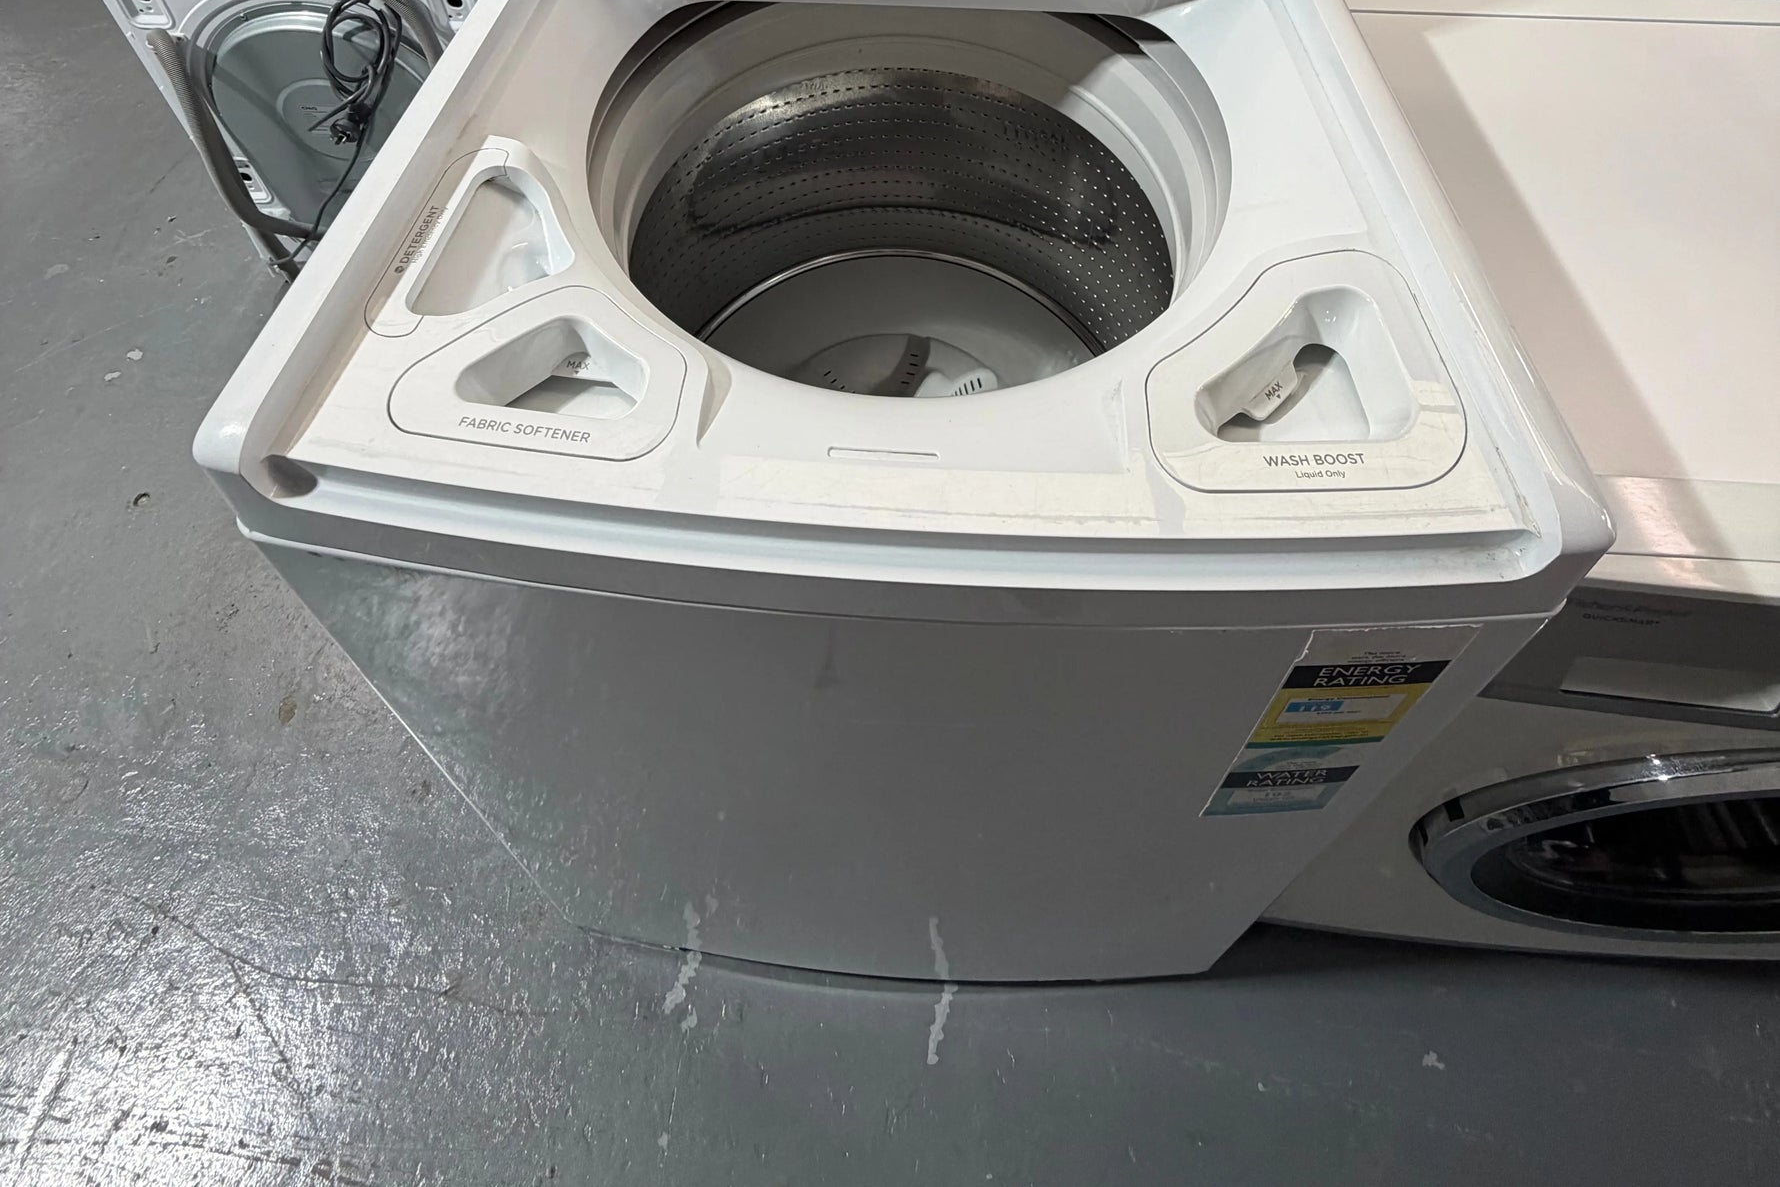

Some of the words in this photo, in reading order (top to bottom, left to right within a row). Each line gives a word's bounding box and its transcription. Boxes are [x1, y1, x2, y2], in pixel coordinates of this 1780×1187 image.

[399, 206, 439, 264] DETERGENT
[566, 359, 589, 371] MAX
[1264, 380, 1284, 401] MAX
[458, 417, 512, 434] FABRIC
[513, 423, 591, 444] SOFTENER
[1263, 454, 1309, 467] WASH
[1313, 453, 1365, 467] BOOST
[1295, 469, 1325, 480] Liquid
[1326, 469, 1346, 480] Only
[1319, 664, 1421, 677] ENERGY
[1313, 674, 1408, 687] RATING
[1257, 769, 1327, 779] WATER
[1246, 777, 1324, 786] RATING
